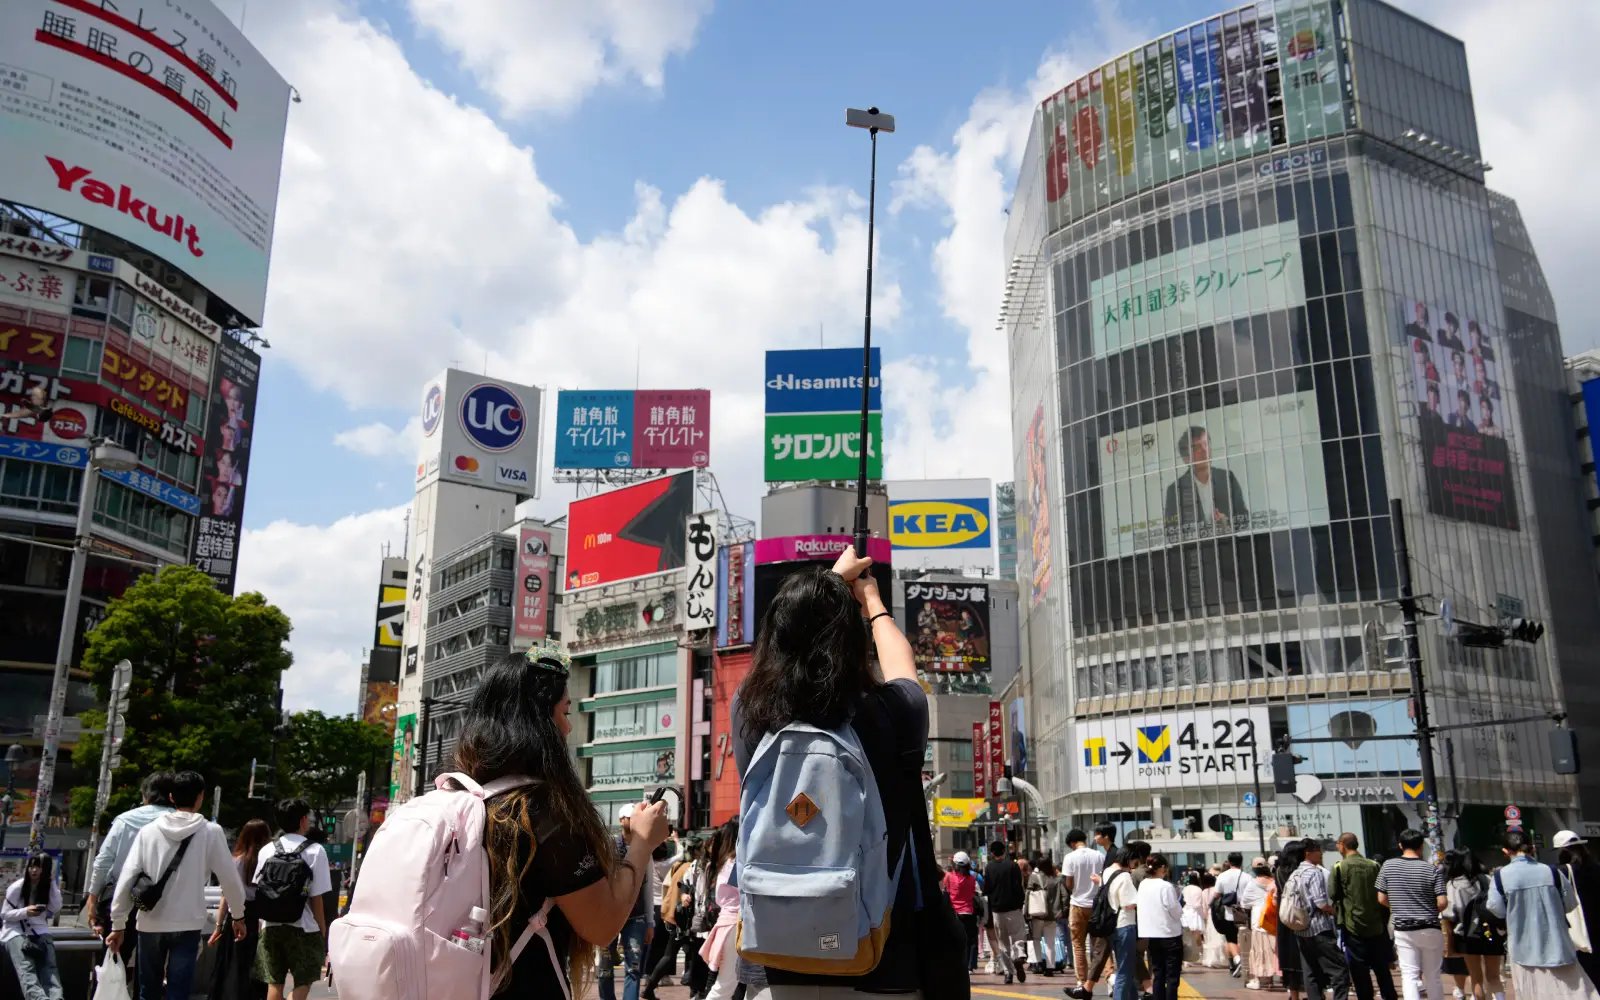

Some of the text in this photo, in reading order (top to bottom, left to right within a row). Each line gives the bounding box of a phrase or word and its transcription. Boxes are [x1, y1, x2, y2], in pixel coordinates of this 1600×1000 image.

[42, 10, 232, 131] 睡眠の質向上
[44, 155, 204, 257] Yakult
[1103, 251, 1292, 328] 大和証券グループ
[102, 348, 185, 409] コンタクト
[766, 374, 880, 391] Hisamitsu
[54, 420, 84, 432] ガスト
[572, 405, 619, 426] 龍角散
[650, 405, 697, 426] 龍角散
[160, 421, 197, 453] ガスト
[771, 431, 876, 460] サロンパス
[499, 466, 528, 483] VISA
[794, 539, 849, 554] Rakuten
[687, 513, 715, 625] もんじゃ
[906, 584, 986, 602] ダンジョン飯
[990, 707, 1002, 758] カラオケ
[1176, 718, 1256, 751] 4.22
[1138, 765, 1172, 777] POINT
[1178, 753, 1252, 775] START
[1331, 785, 1395, 797] TSUTAYA
[1300, 821, 1326, 830] OPEN
